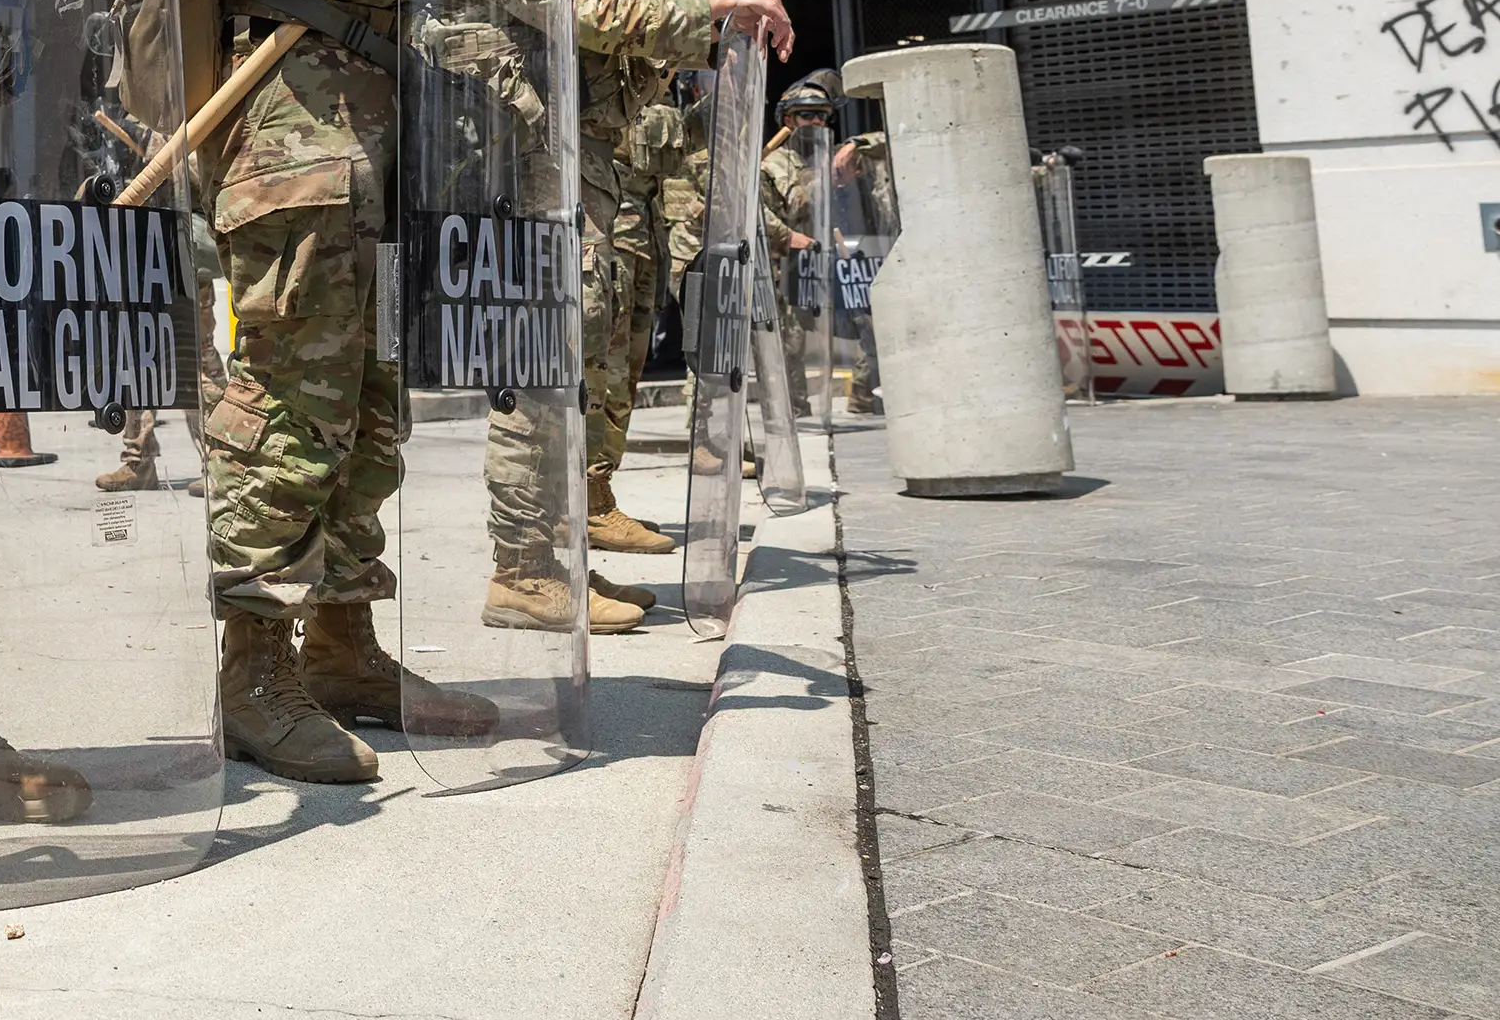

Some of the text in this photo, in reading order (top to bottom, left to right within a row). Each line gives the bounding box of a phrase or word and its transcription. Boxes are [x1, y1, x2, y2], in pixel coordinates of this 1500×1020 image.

[1015, 0, 1110, 25] CLEARANCE
[54, 308, 177, 411] GUARD
[440, 304, 569, 388] NATIONAL
[1058, 318, 1215, 368] STOP
